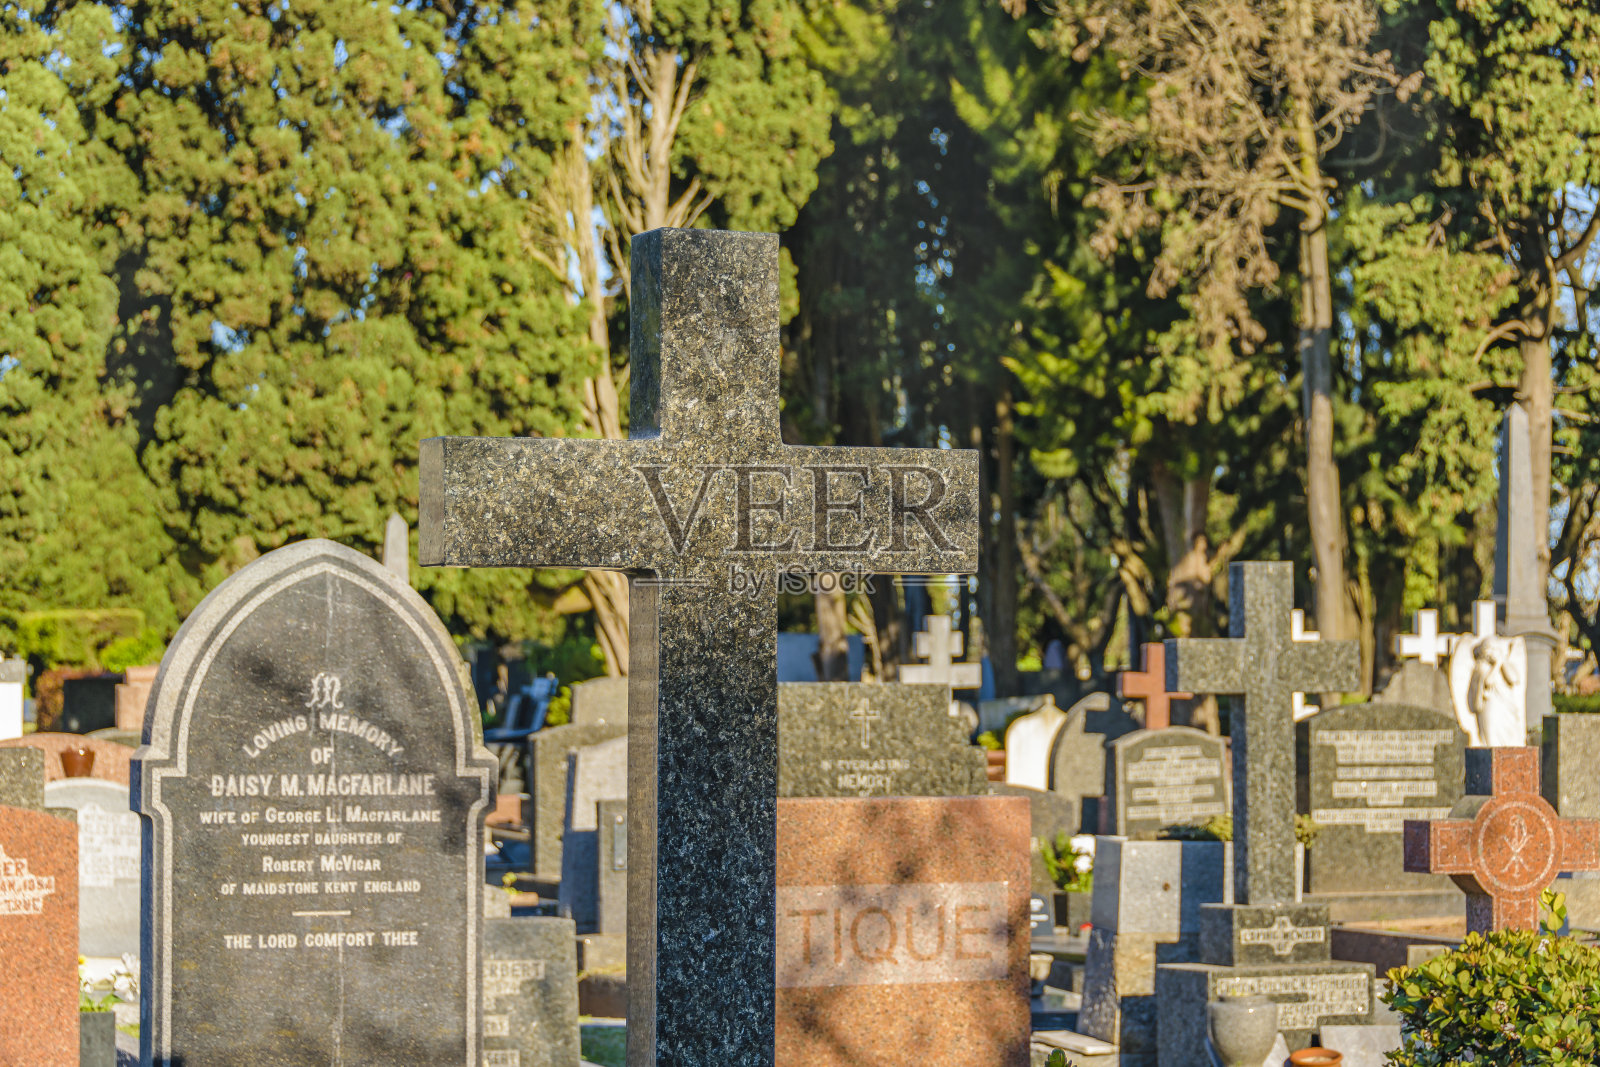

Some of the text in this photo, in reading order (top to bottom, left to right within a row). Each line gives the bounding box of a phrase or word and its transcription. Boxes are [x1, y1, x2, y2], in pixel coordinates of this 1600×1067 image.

[242, 712, 404, 759] LOVING MEMORY
[311, 747, 334, 764] OF
[211, 774, 436, 796] DAISY M. MACFARLANE
[200, 811, 236, 824] WIFE
[241, 811, 259, 824] OF
[265, 807, 322, 823] GEORGE
[326, 806, 342, 823] L.
[241, 832, 402, 846] YOUNGEST DAUGHTER OF
[262, 856, 314, 872] ROBERT
[221, 880, 421, 895] OF MAIDSTONE KENT ENGLAND
[223, 930, 418, 949] THE LORD COMFORT THEE
